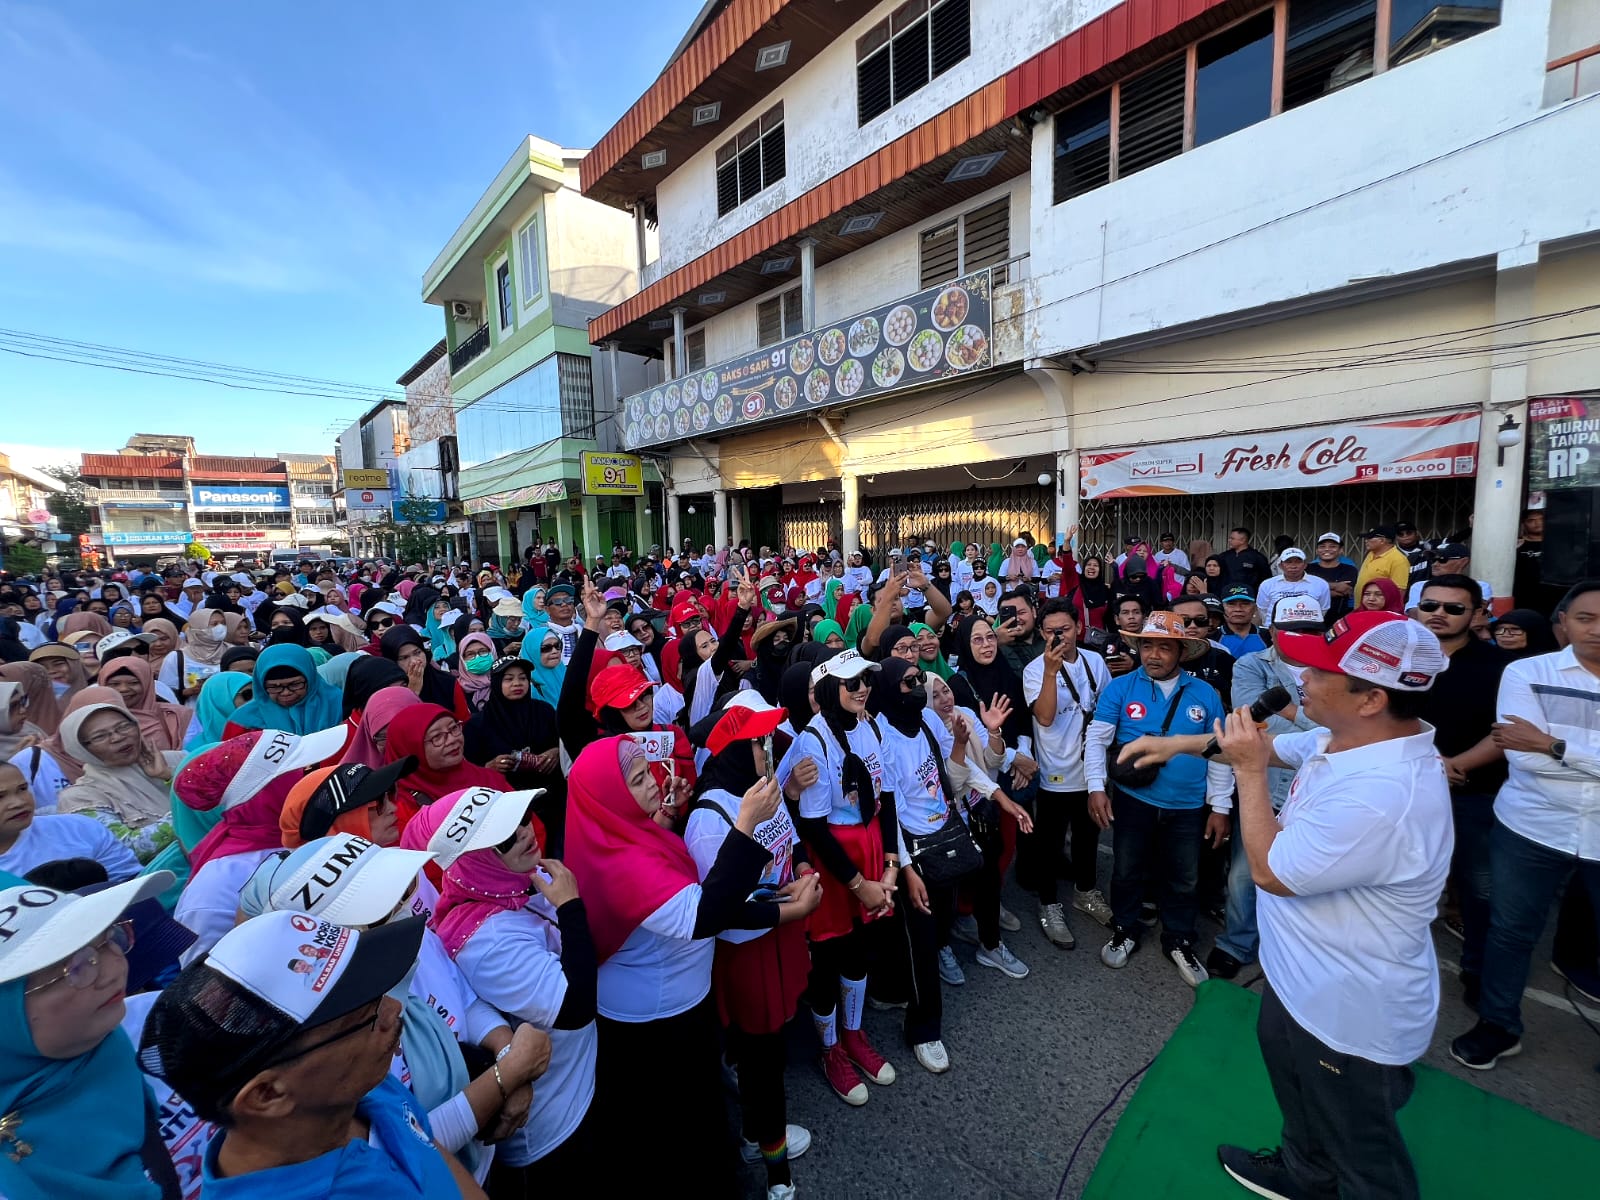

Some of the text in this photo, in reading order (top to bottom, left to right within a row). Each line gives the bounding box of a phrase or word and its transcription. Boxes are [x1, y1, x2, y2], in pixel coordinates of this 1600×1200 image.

[750, 359, 770, 374] SAPI
[771, 348, 786, 368] 91
[747, 398, 761, 413] 91
[1548, 419, 1600, 436] MURNI
[1548, 432, 1600, 448] TANPA
[1215, 436, 1368, 479] Fresh Cola
[1548, 447, 1590, 479] RP
[604, 467, 626, 483] 91
[1360, 467, 1374, 477] 16
[1394, 462, 1446, 475] 30.000
[349, 473, 382, 482] realme
[199, 489, 283, 503] Panasonic
[1129, 703, 1144, 719] 2
[316, 957, 336, 988] KALBAR
[1319, 1060, 1341, 1074] BOSS
